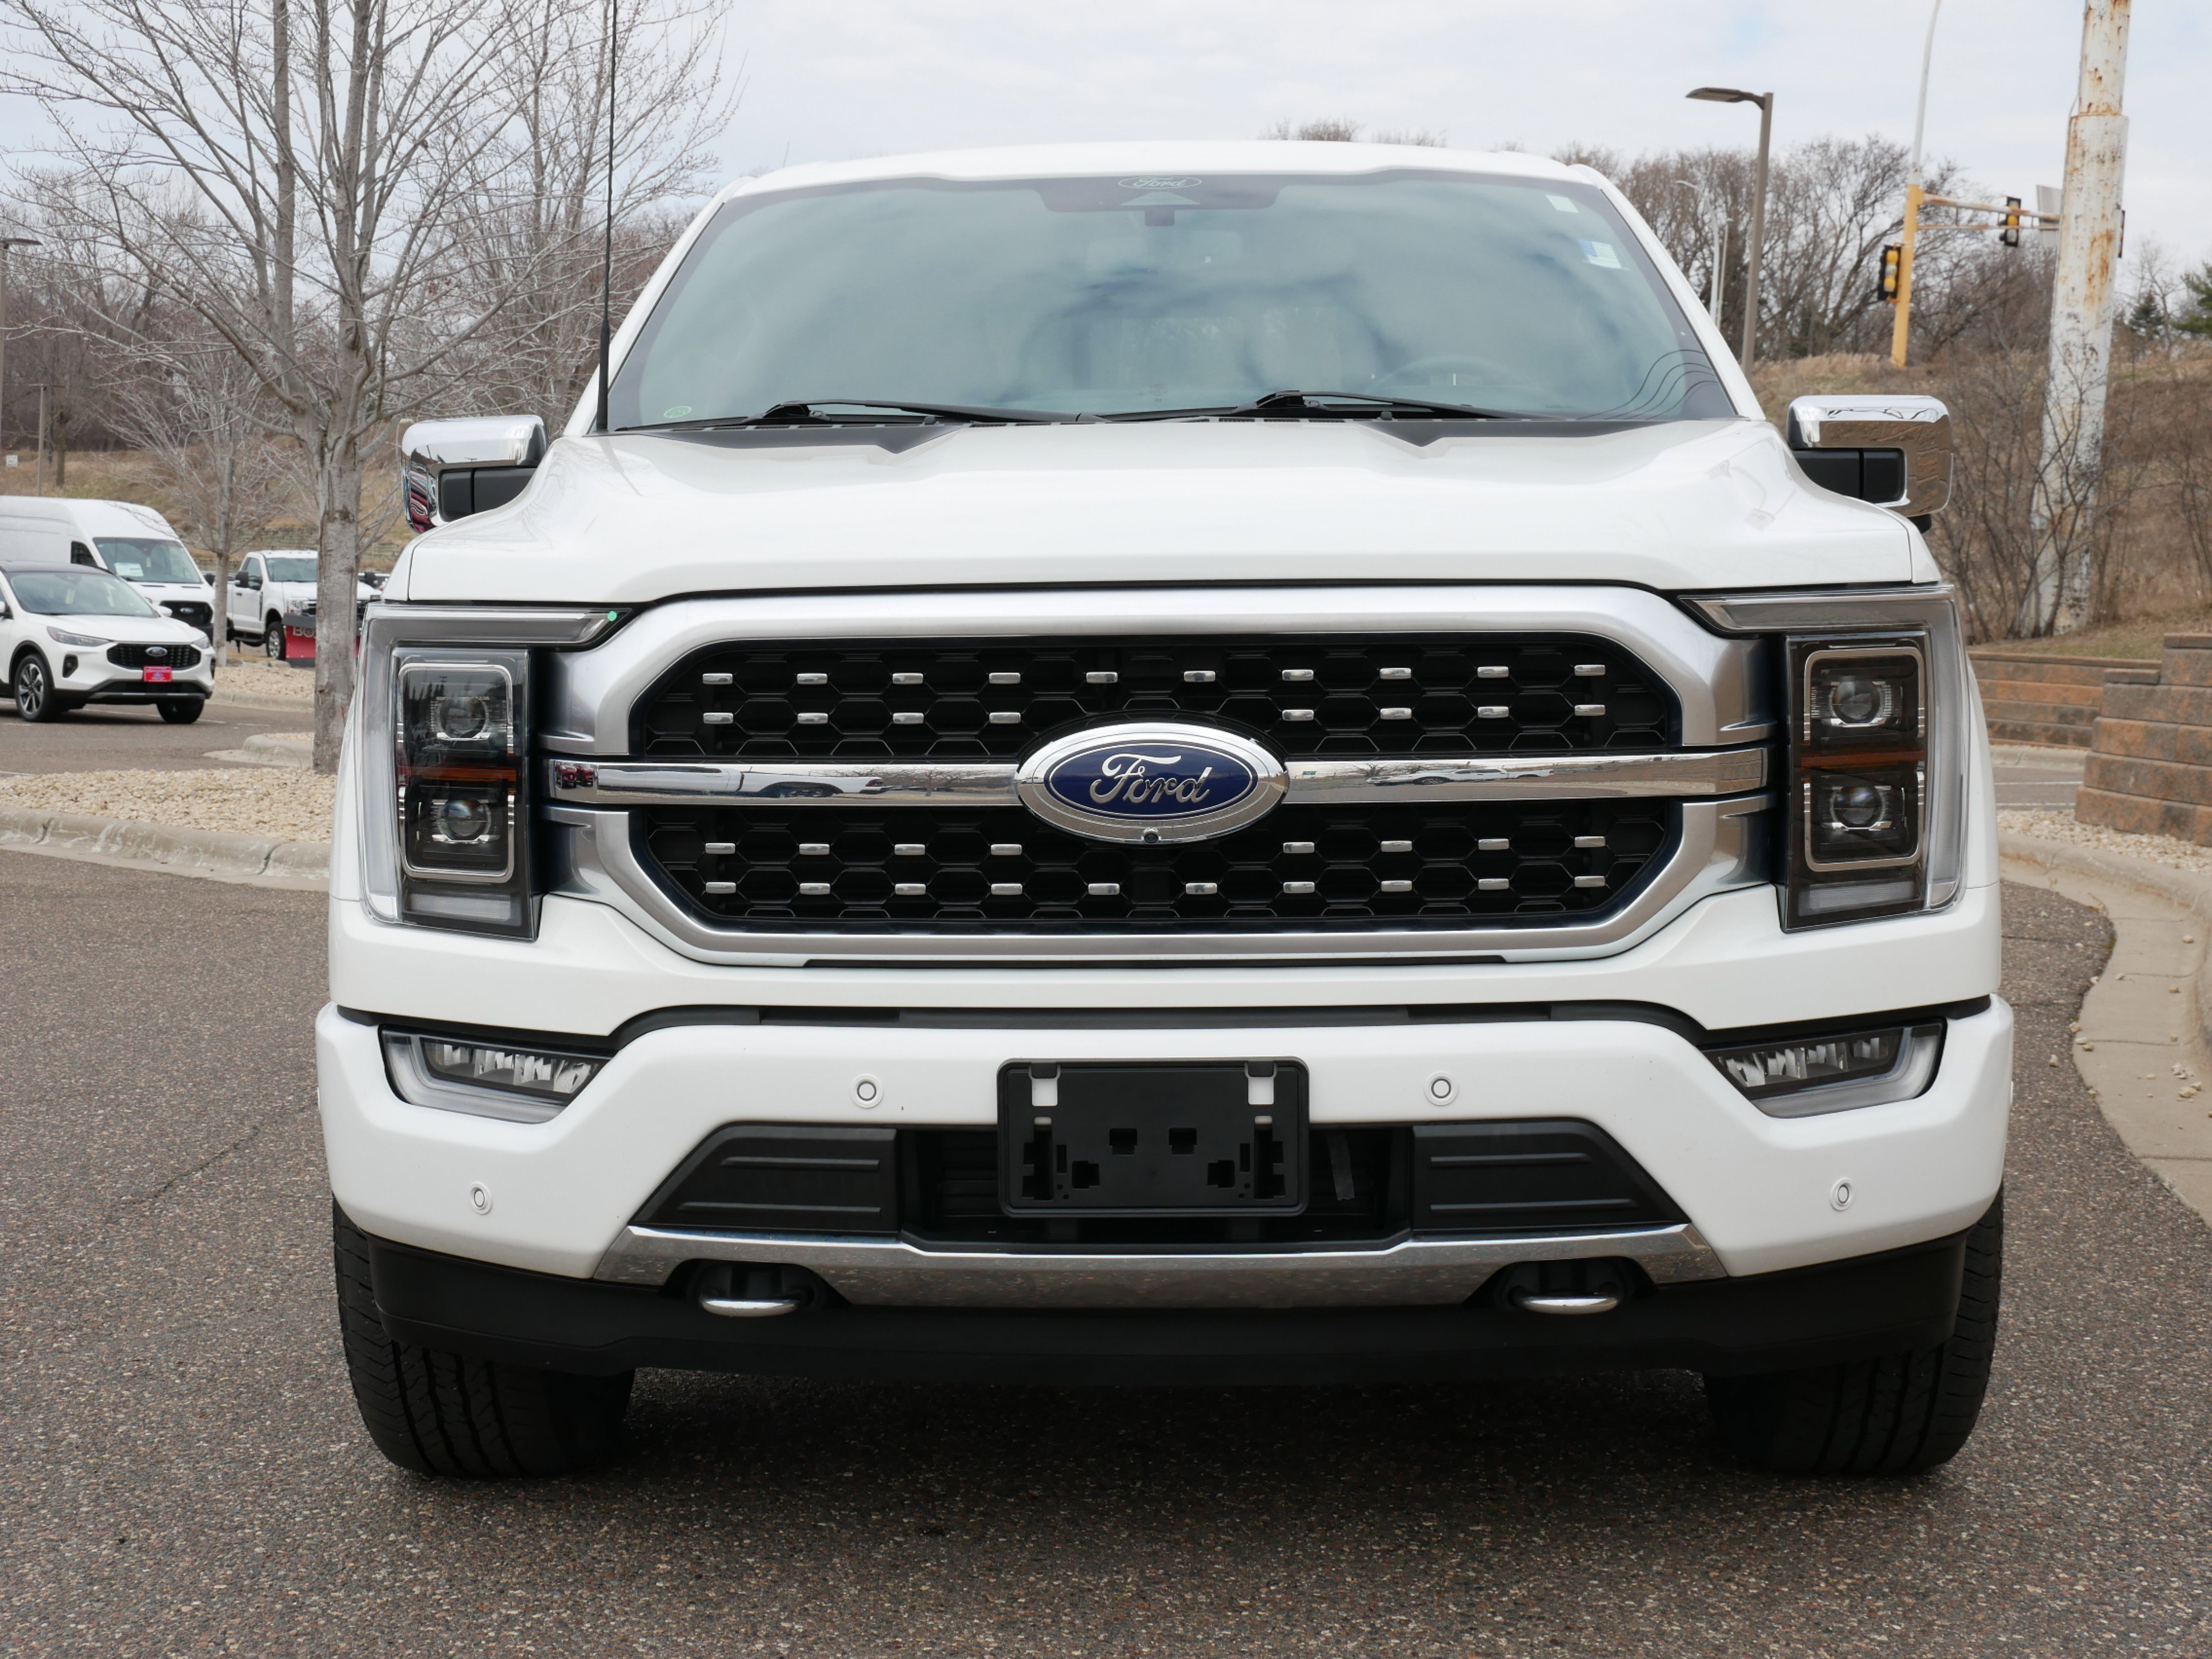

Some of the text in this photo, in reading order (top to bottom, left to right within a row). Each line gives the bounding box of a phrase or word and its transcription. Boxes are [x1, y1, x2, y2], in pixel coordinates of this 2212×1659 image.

[1133, 178, 1186, 187] Ford
[293, 626, 316, 638] BO
[1089, 753, 1213, 803] Ford
